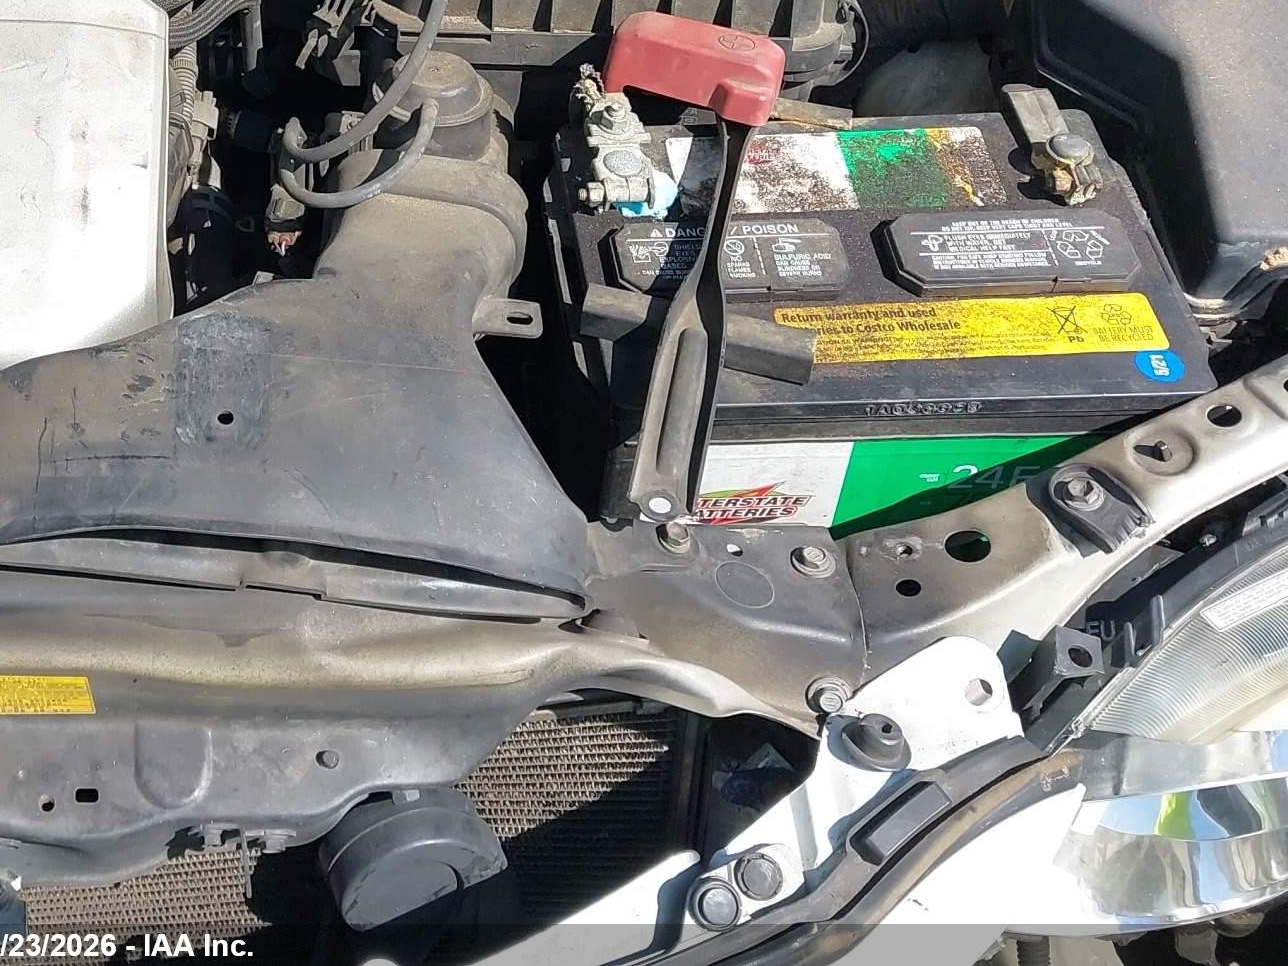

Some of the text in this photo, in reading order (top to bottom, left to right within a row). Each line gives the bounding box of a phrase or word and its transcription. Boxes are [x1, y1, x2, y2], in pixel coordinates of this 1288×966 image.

[665, 226, 706, 238] DANG
[741, 223, 800, 234] POISON
[781, 307, 937, 323] Return warranty and used
[841, 325, 854, 334] to
[856, 321, 895, 333] Costco
[896, 319, 961, 332] Wholesale
[1130, 325, 1153, 334] MUST
[1068, 335, 1084, 343] Pb
[1111, 334, 1154, 342] RECYCLED
[698, 497, 807, 507] TERSTATE
[695, 508, 797, 518] ATTERIES
